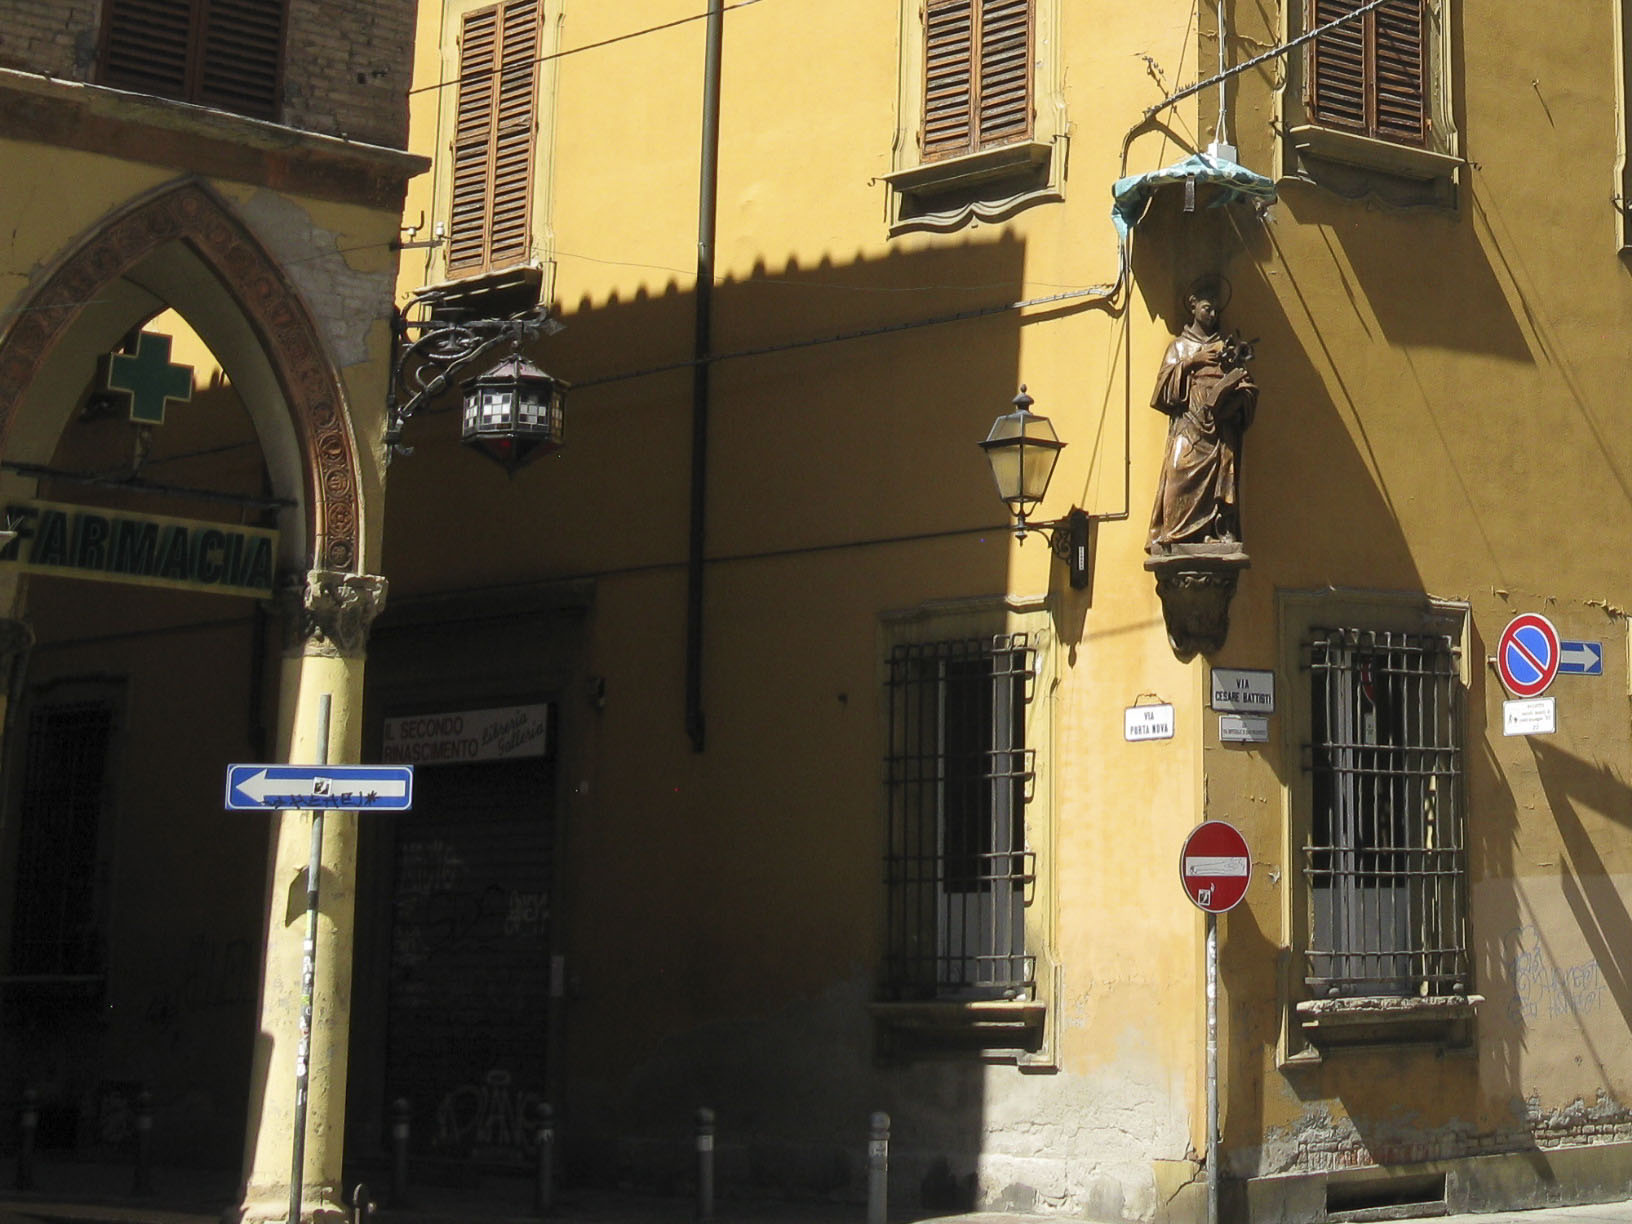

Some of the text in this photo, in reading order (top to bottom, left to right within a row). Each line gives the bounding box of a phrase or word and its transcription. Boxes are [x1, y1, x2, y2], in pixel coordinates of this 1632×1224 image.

[0, 504, 273, 588] FARMACIA
[1236, 678, 1250, 689] VIA
[1215, 690, 1272, 705] CESARE BATTISTI
[1143, 711, 1155, 721] VIA
[384, 716, 464, 741] IL SECONDO
[1130, 721, 1169, 735] PORTA NOVA
[384, 738, 480, 763] RINASCIMENTO
